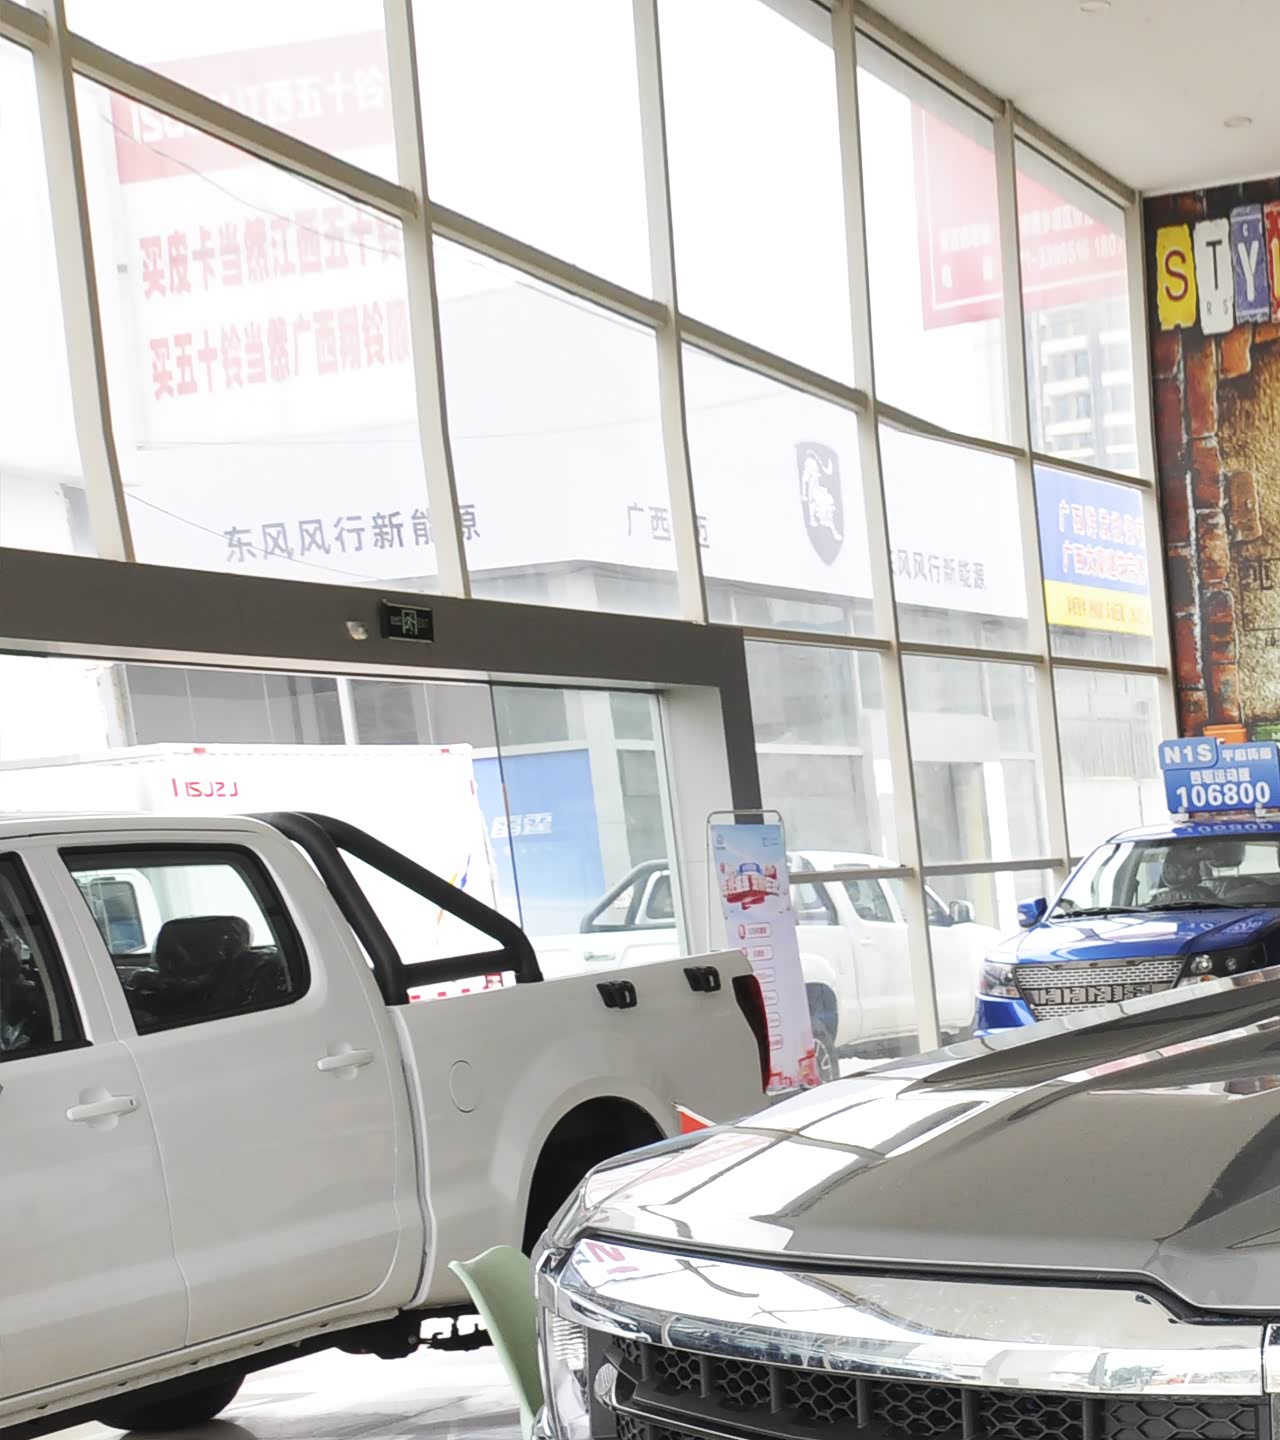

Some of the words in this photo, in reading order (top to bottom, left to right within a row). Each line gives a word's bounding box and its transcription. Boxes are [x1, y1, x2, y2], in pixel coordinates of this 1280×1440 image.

[890, 548, 985, 590] 风风行新能源
[1164, 743, 1213, 765] N1S
[1176, 781, 1272, 808] 106800
